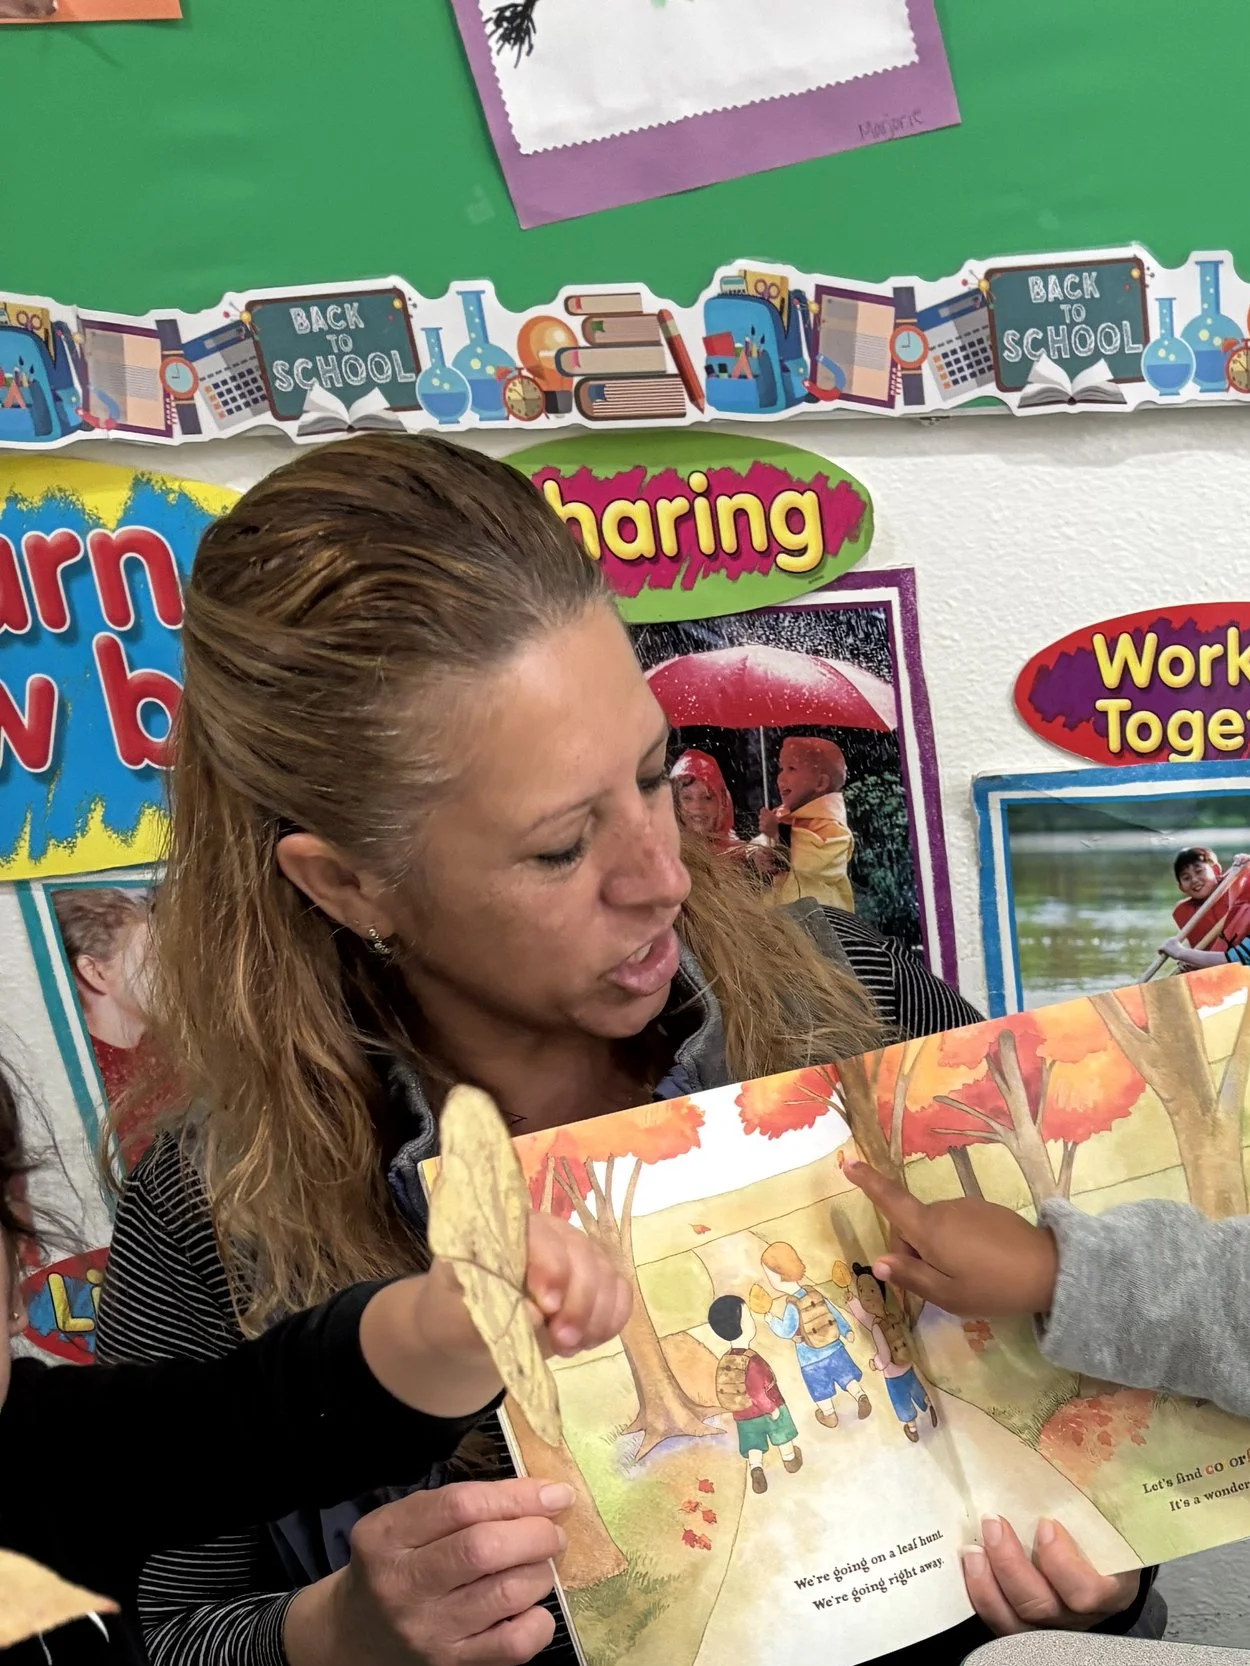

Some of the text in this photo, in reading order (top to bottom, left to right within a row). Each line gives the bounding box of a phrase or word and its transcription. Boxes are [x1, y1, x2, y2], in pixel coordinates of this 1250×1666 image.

[1028, 272, 1100, 303] BACK
[289, 302, 365, 334] BACK
[1060, 303, 1086, 324] TO
[326, 333, 353, 353] TO
[1003, 320, 1143, 363] SCHOOL
[272, 350, 416, 392] SCHOOL
[542, 472, 823, 573] haring
[1142, 1478, 1174, 1494] Let's
[1176, 1468, 1203, 1485] find
[1169, 1497, 1190, 1512] It's
[1193, 1495, 1201, 1505] a
[794, 1572, 830, 1591] We're
[832, 1557, 870, 1583] going
[870, 1553, 887, 1566] on
[889, 1549, 897, 1559] a
[896, 1537, 919, 1556] leaf
[812, 1556, 945, 1611] We're going right away.
